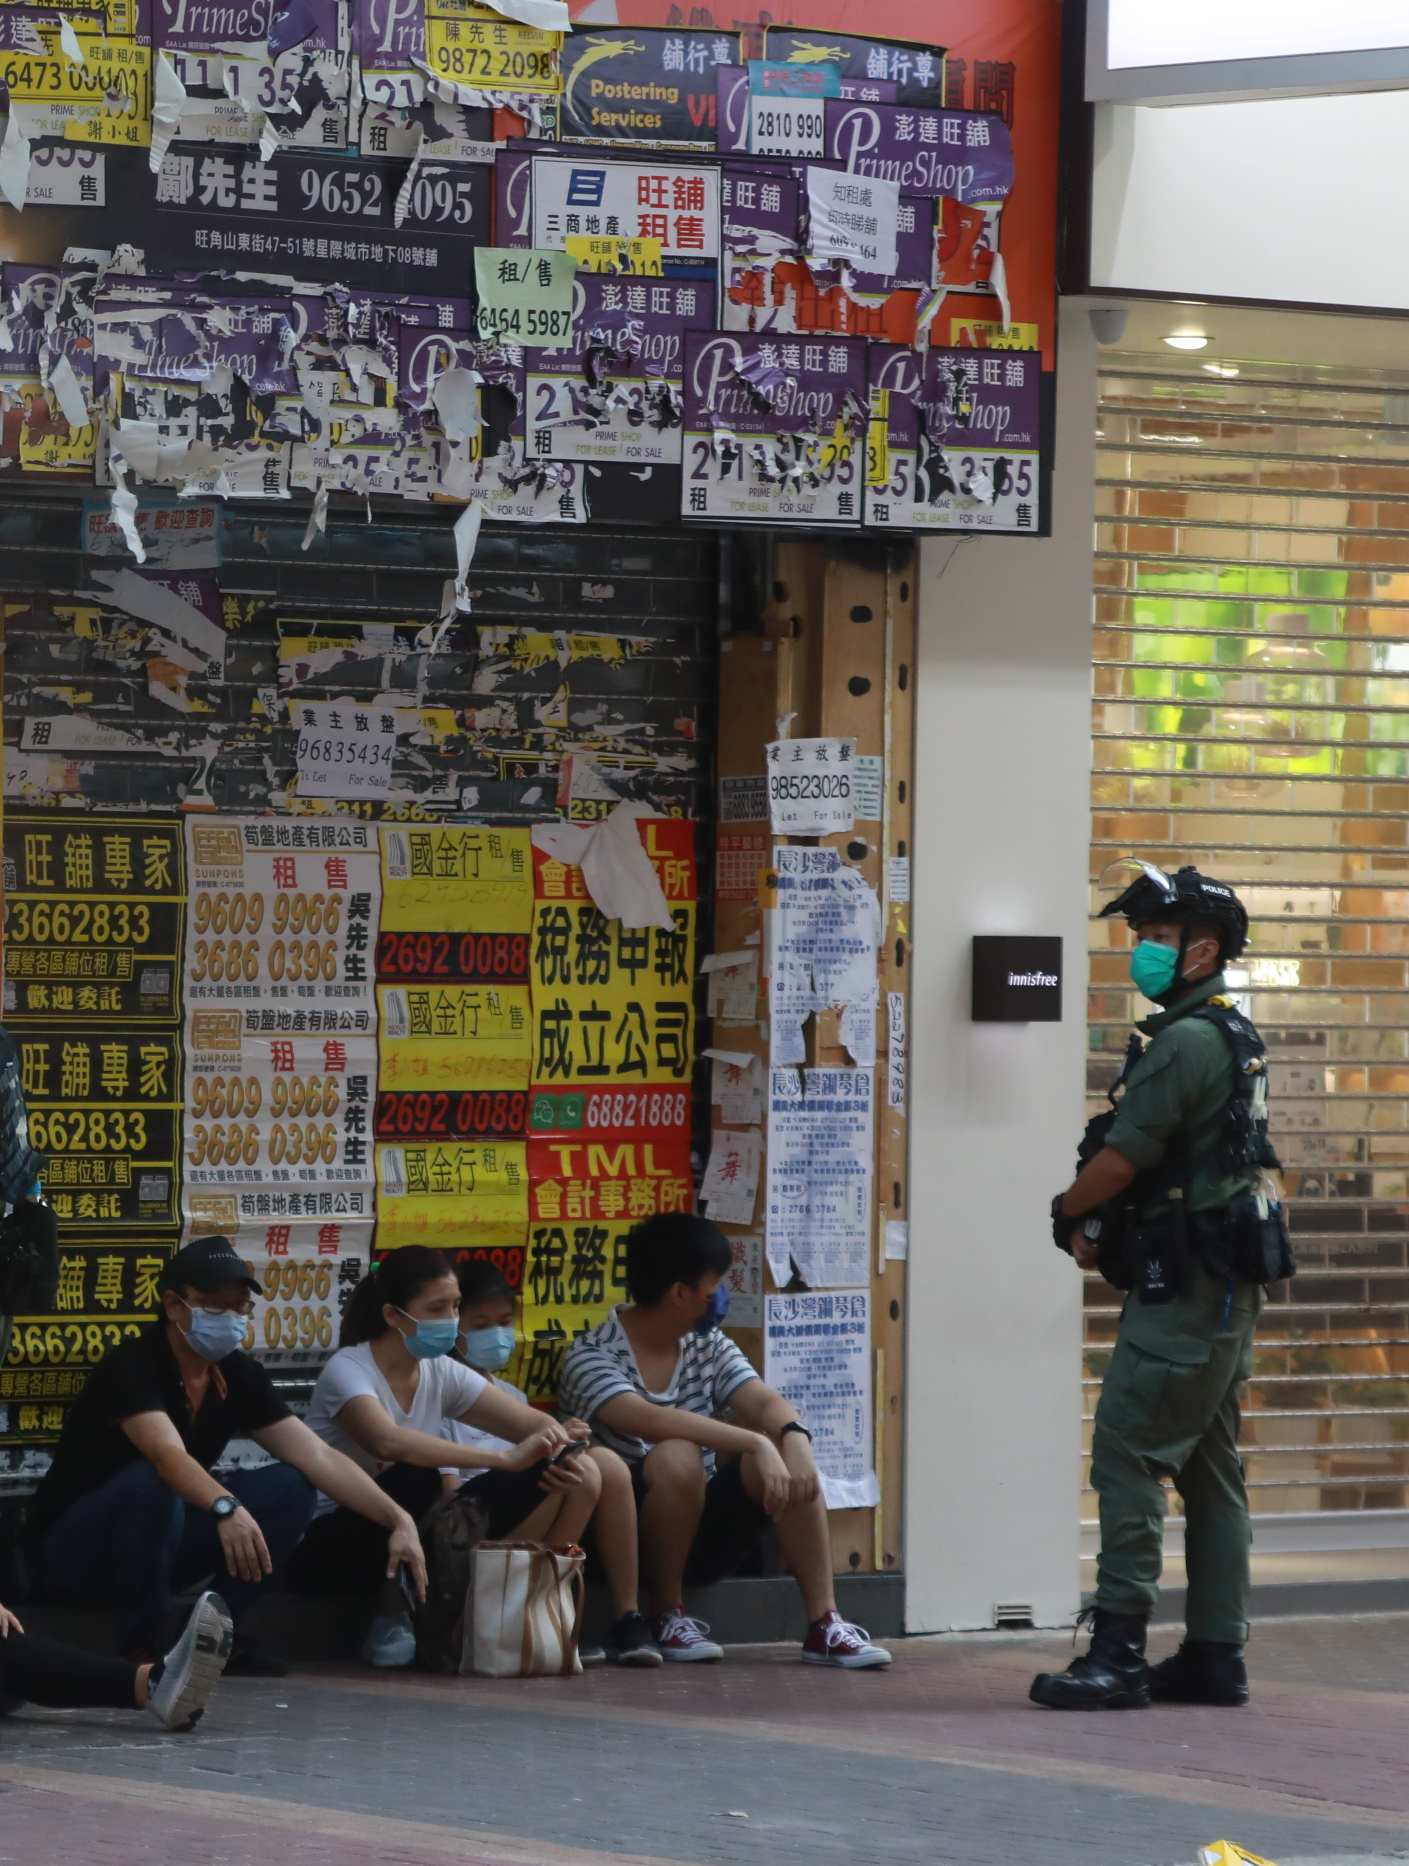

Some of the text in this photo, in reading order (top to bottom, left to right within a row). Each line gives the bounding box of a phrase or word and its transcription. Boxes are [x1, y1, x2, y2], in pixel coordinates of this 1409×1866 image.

[445, 21, 509, 46] 陳先生
[4, 60, 61, 90] 6473
[437, 47, 492, 77] 9872
[591, 79, 679, 103] Postering
[50, 104, 75, 115] PRIME
[591, 110, 662, 128] Services
[321, 118, 339, 143] 售
[758, 111, 791, 137] 2810
[894, 114, 990, 147] 澎達旺舖
[369, 125, 388, 151] 租
[461, 145, 477, 157] FOR
[78, 174, 98, 201] 售
[300, 168, 382, 217] 9652
[637, 175, 706, 211] 旺舖
[546, 213, 620, 236] 三商地產
[637, 213, 706, 250] 租售
[497, 258, 553, 287] 租/售
[601, 284, 696, 316] 澎達旺舖
[479, 309, 571, 336] 6464 5987
[758, 344, 848, 374] 澎達旺舖
[534, 430, 552, 455] 租
[595, 431, 617, 441] PRIME
[627, 447, 642, 457] FOR
[645, 447, 662, 458] SALE
[559, 490, 577, 519] 售
[690, 487, 707, 511] 租
[748, 487, 770, 497] PRIME
[837, 492, 854, 516] 售
[497, 505, 534, 517] FOR SALE
[779, 503, 794, 513] FOR
[797, 503, 814, 514] SALE
[873, 503, 890, 522] 租
[960, 514, 974, 523] FOR
[977, 514, 993, 524] SALE
[1016, 503, 1032, 527] 售
[31, 722, 52, 745] 租
[302, 708, 395, 734] 業主放盤
[298, 738, 392, 765] 96835434
[770, 744, 853, 762] 業主放盤
[313, 770, 327, 782] Let
[348, 774, 364, 786] For
[368, 775, 387, 787] Sale
[771, 774, 851, 800] 98523026
[781, 811, 852, 821] Let For Sale
[244, 824, 368, 848] 筍盤地產有限公司
[25, 833, 173, 890] 旺舖專家
[409, 831, 524, 879] 國金行 租/售
[1201, 884, 1231, 897] POLICE
[194, 891, 343, 935] 9609 9966
[344, 892, 372, 982] 吳先生
[190, 939, 338, 982] 3686 0396
[380, 933, 526, 974] 2692 0088
[1007, 970, 1058, 986] innisfree
[27, 984, 122, 1011] 歡迎委託
[245, 1009, 370, 1031] 筍盤地產有限公司
[407, 989, 524, 1037] 國金行 租/售
[536, 997, 690, 1079] 成立公司
[22, 1041, 169, 1097] 旺舖專家
[191, 1075, 340, 1119] 9609 9966
[587, 1093, 686, 1128] 68821888
[344, 1075, 369, 1165] 吳先生
[379, 1092, 525, 1132] 2692 0088
[28, 1112, 147, 1150] 662833
[189, 1123, 337, 1166] 3686 0396
[405, 1146, 520, 1194] 國金行 租/售
[549, 1143, 673, 1178] TML
[241, 1192, 364, 1216] 筍盤地產有限公司
[535, 1178, 689, 1219] 會計事務所
[262, 1259, 333, 1301] 9966
[263, 1306, 332, 1349] 0396
